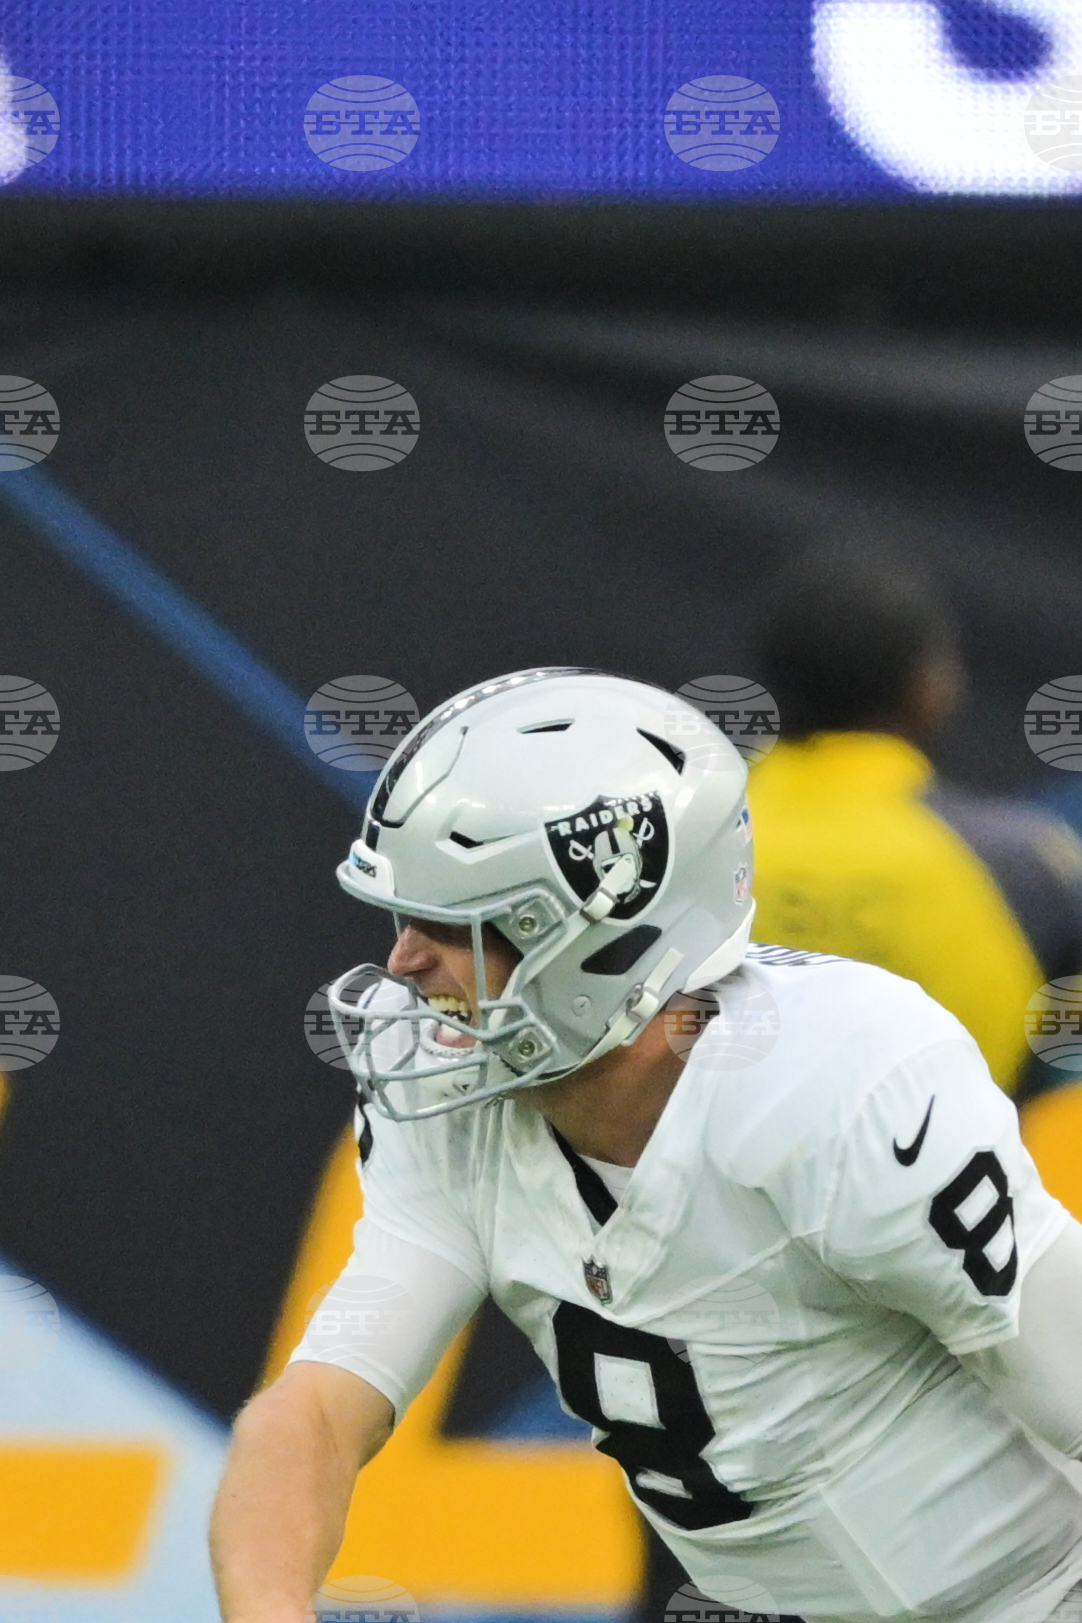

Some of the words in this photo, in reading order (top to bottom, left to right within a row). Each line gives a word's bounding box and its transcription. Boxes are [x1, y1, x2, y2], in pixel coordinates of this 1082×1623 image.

[557, 797, 654, 837] RAIDERS
[929, 1149, 1018, 1297] 8
[552, 1299, 757, 1532] 8
